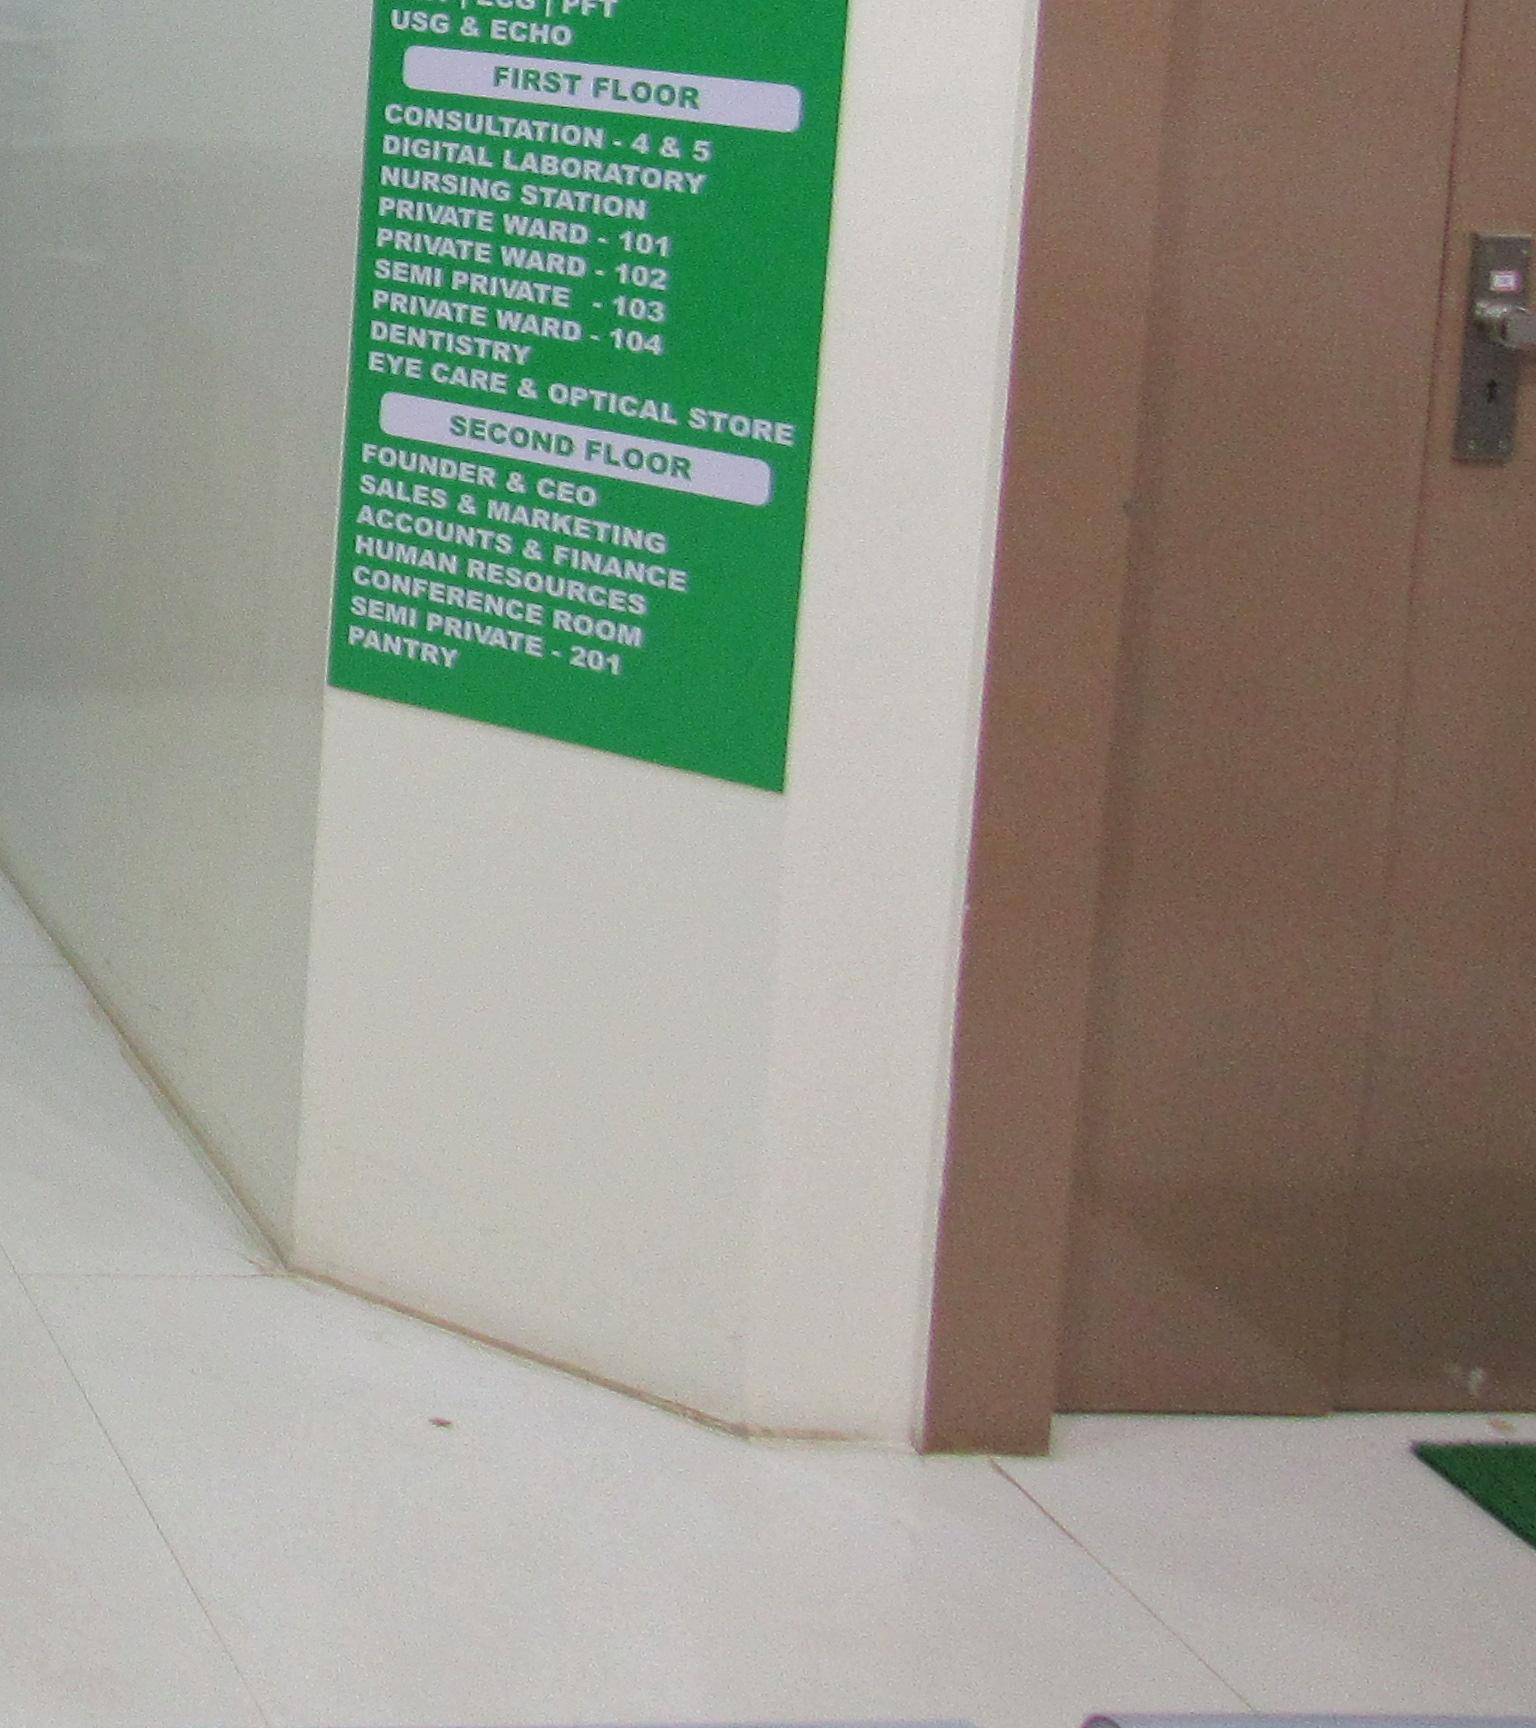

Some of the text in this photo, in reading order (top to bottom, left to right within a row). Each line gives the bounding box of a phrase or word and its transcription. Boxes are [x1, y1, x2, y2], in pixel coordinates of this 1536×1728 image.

[391, 9, 573, 47] USG & ECHO
[493, 66, 701, 109] FIRST FLOOR
[383, 134, 707, 195] DIGITAL LABORATORY
[385, 103, 713, 163] CONSULTATION 4 & 5
[380, 165, 648, 220] NURSING STATION
[378, 196, 672, 257] PRIVATE WARD 101
[374, 258, 667, 322] SEMI PRIVATE 103
[376, 227, 669, 291] PRIVATE WARD 102
[370, 321, 532, 365] DENTISTRY
[372, 289, 664, 355] PRIVATE WARD 104
[368, 351, 796, 446] EYE CARE & OPTICAL STORE
[362, 443, 599, 507] FOUNDER & CEO
[449, 415, 693, 481] SECOND FLOOR
[359, 474, 668, 554] SALES & MARKETING
[354, 535, 648, 616] HUMAN RESOURCES
[356, 504, 688, 592] ACCOUNTS & FINANCE
[350, 595, 624, 675] SEMI PRIVATE 201
[352, 566, 645, 649] CONFERENCE ROOM
[348, 625, 460, 670] PANTRY
